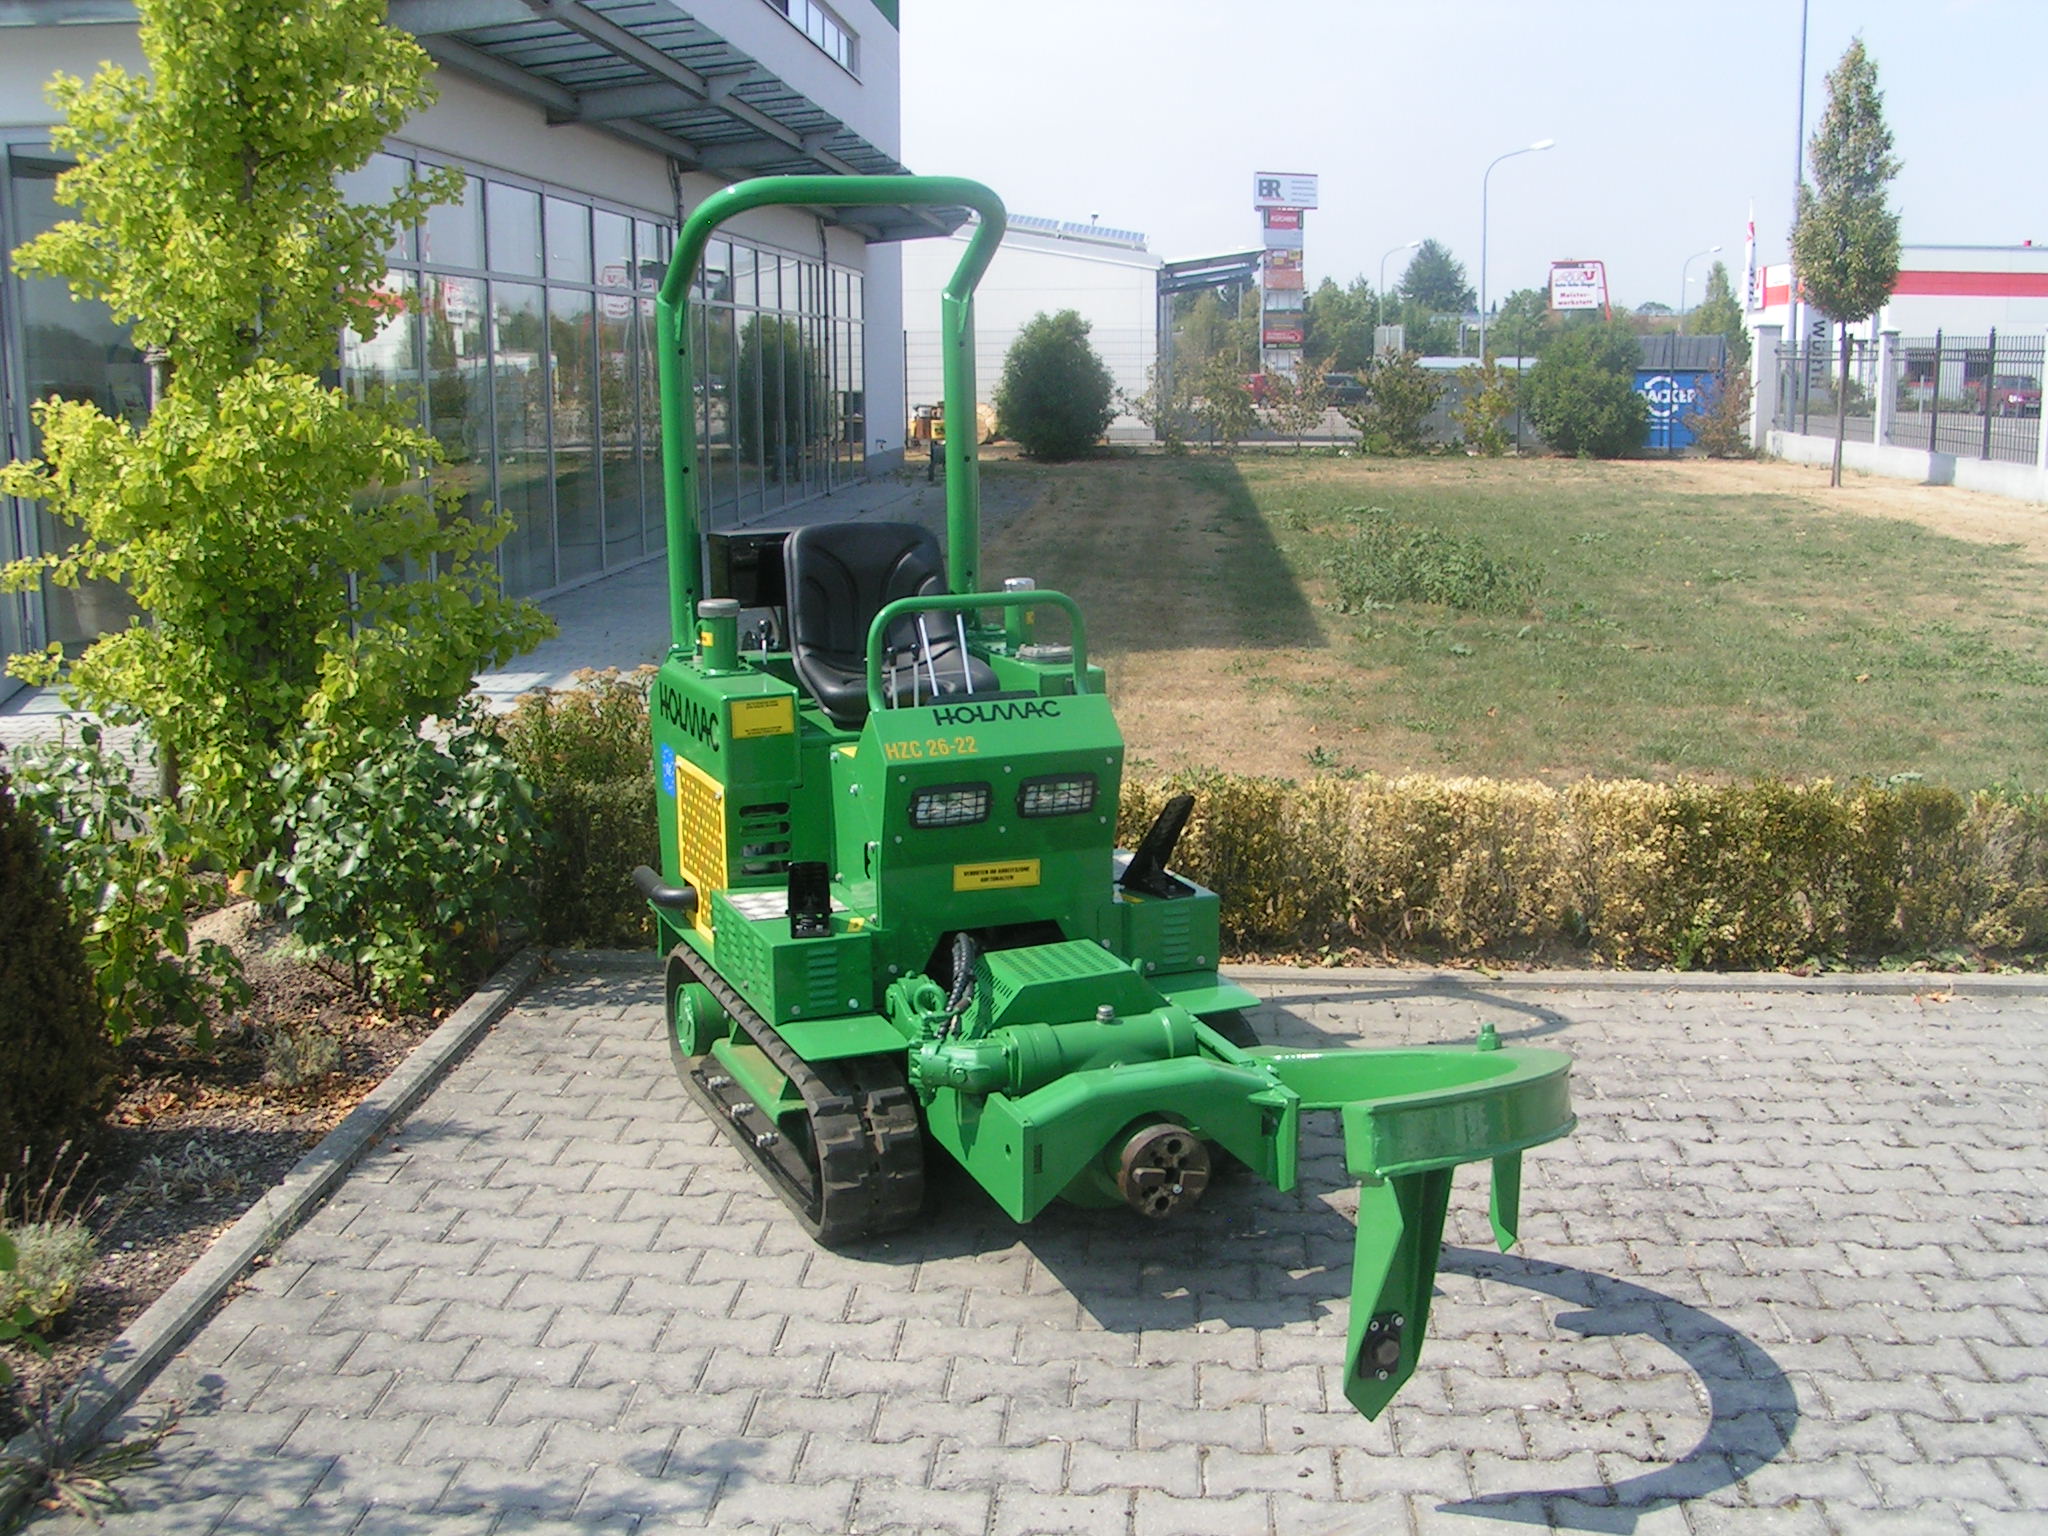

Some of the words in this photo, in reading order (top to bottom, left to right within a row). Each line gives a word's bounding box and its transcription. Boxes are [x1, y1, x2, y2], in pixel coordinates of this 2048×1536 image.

[659, 681, 720, 752] HOLMAC
[932, 700, 1061, 726] HOLMAC
[885, 740, 923, 760] HZC
[926, 736, 978, 757] 26-22
